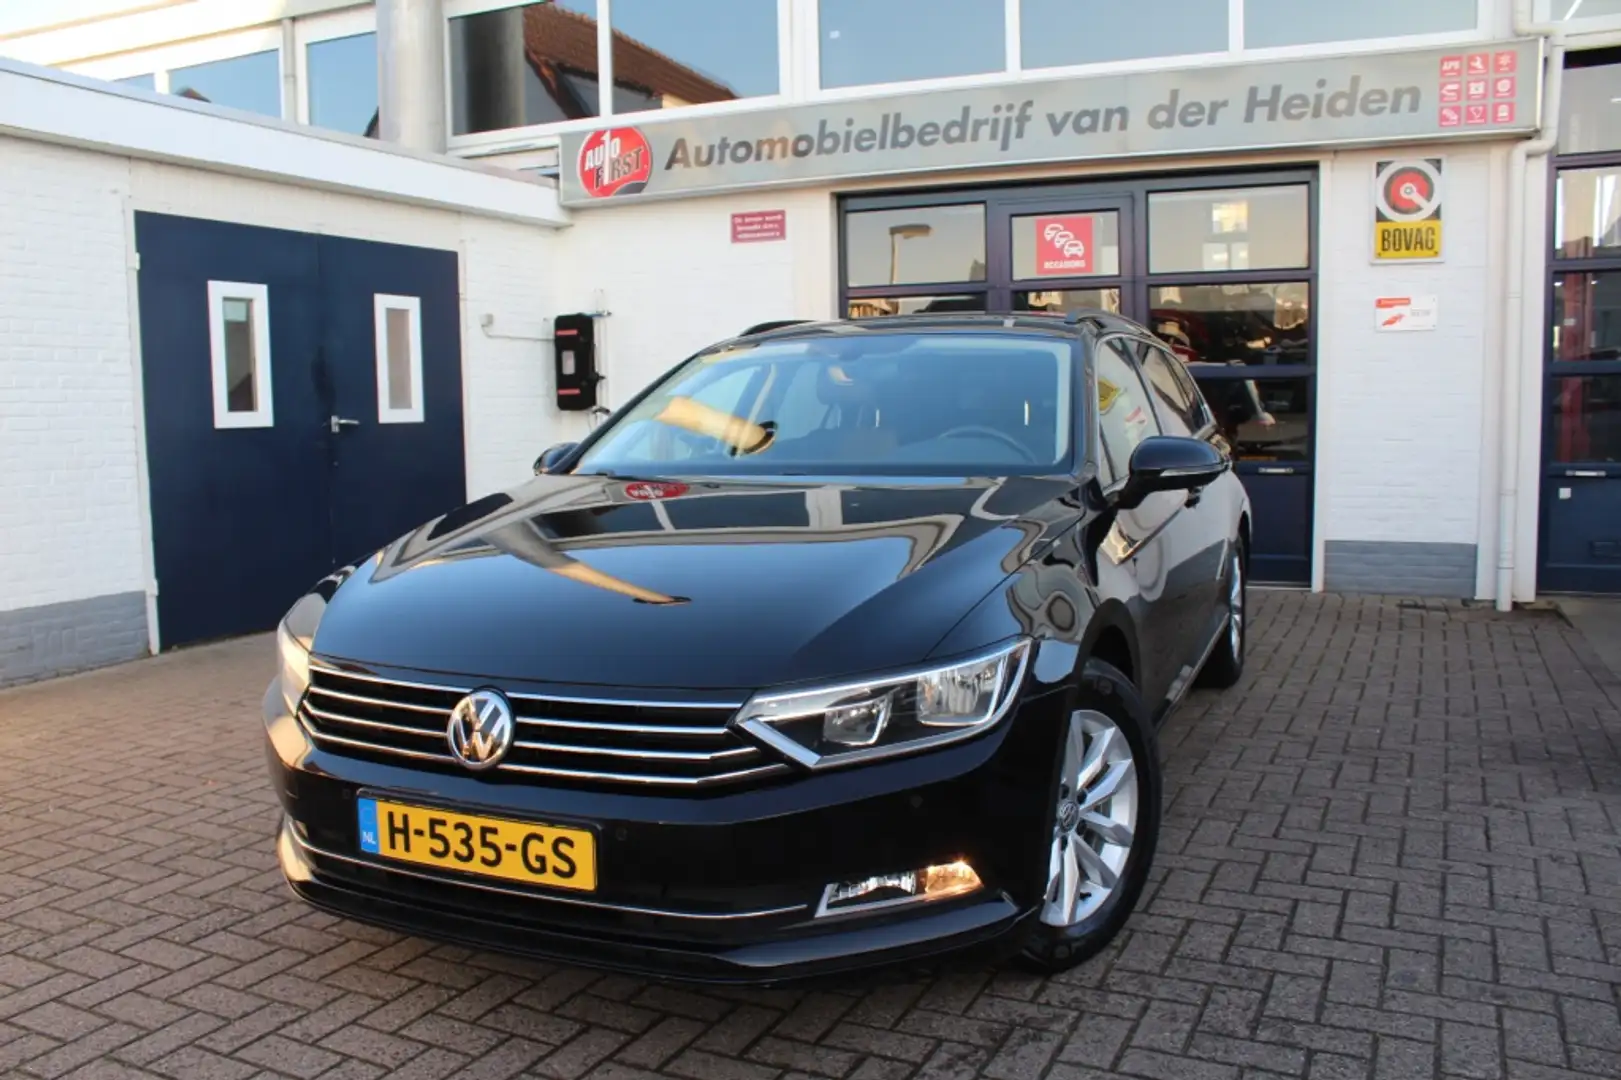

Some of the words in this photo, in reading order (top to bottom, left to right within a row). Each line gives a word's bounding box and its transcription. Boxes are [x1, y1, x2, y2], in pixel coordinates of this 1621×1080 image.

[665, 100, 1034, 170] Automobielbedrijf
[1046, 105, 1129, 137] van
[1147, 89, 1229, 131] der
[1243, 75, 1422, 125] Heiden
[1381, 226, 1436, 252] BOVAG
[362, 830, 377, 846] NL
[387, 810, 577, 879] H-535-GS
